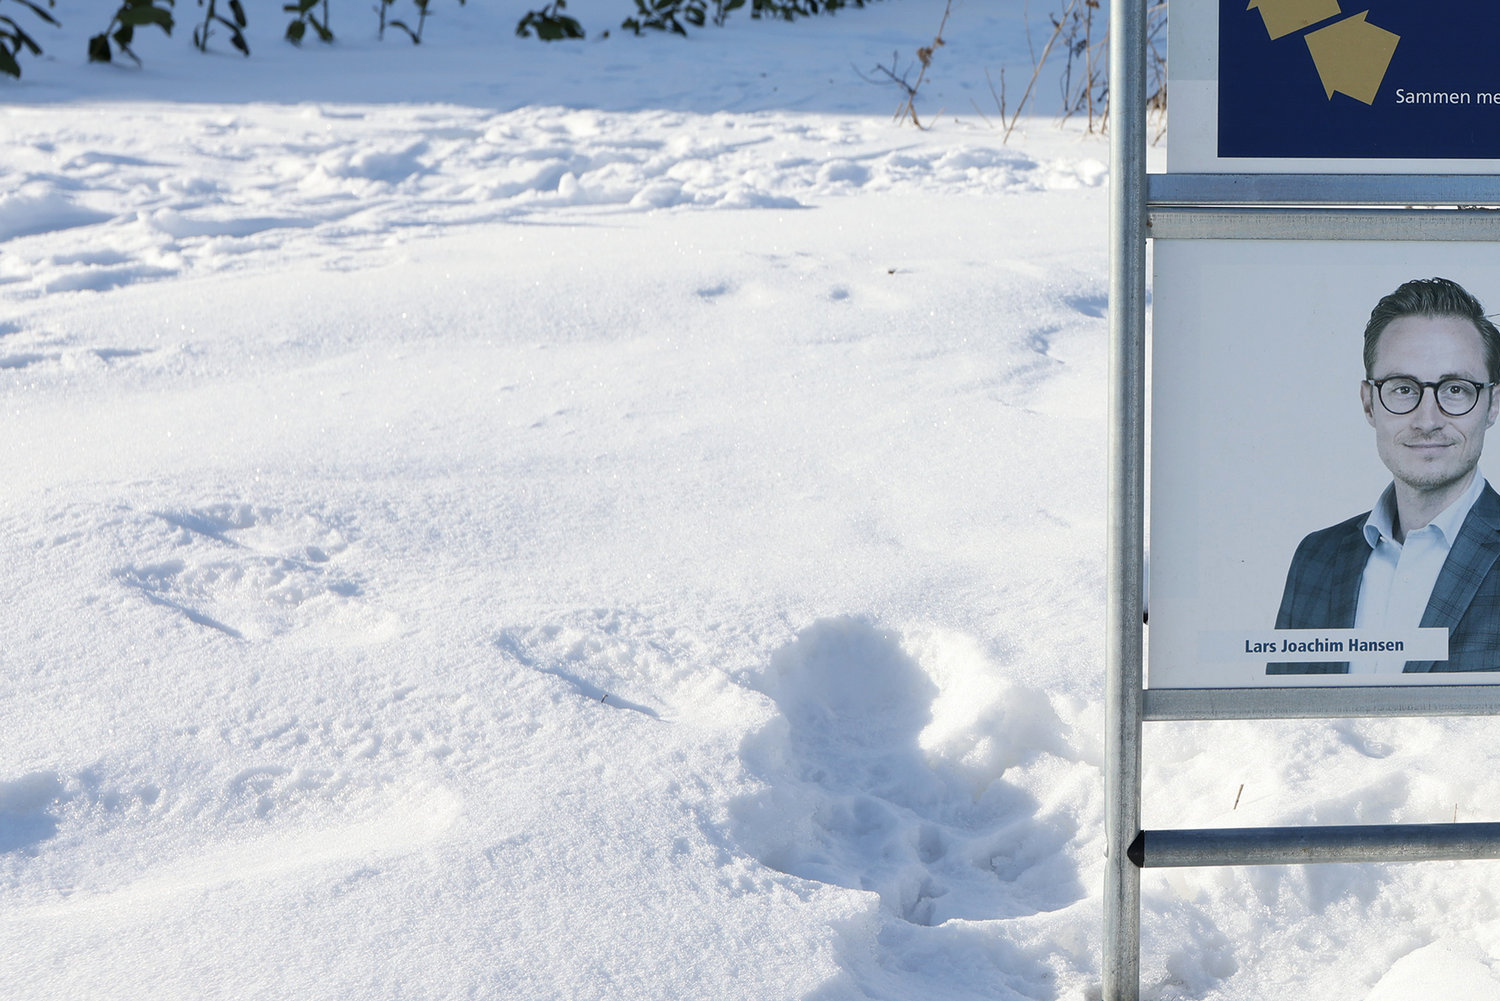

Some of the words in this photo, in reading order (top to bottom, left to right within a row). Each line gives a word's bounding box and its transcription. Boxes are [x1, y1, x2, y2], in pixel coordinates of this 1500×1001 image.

[1395, 88, 1471, 104] Sammen
[1245, 639, 1276, 653] Lars
[1281, 638, 1343, 653] Joachim
[1348, 638, 1404, 652] Hansen
